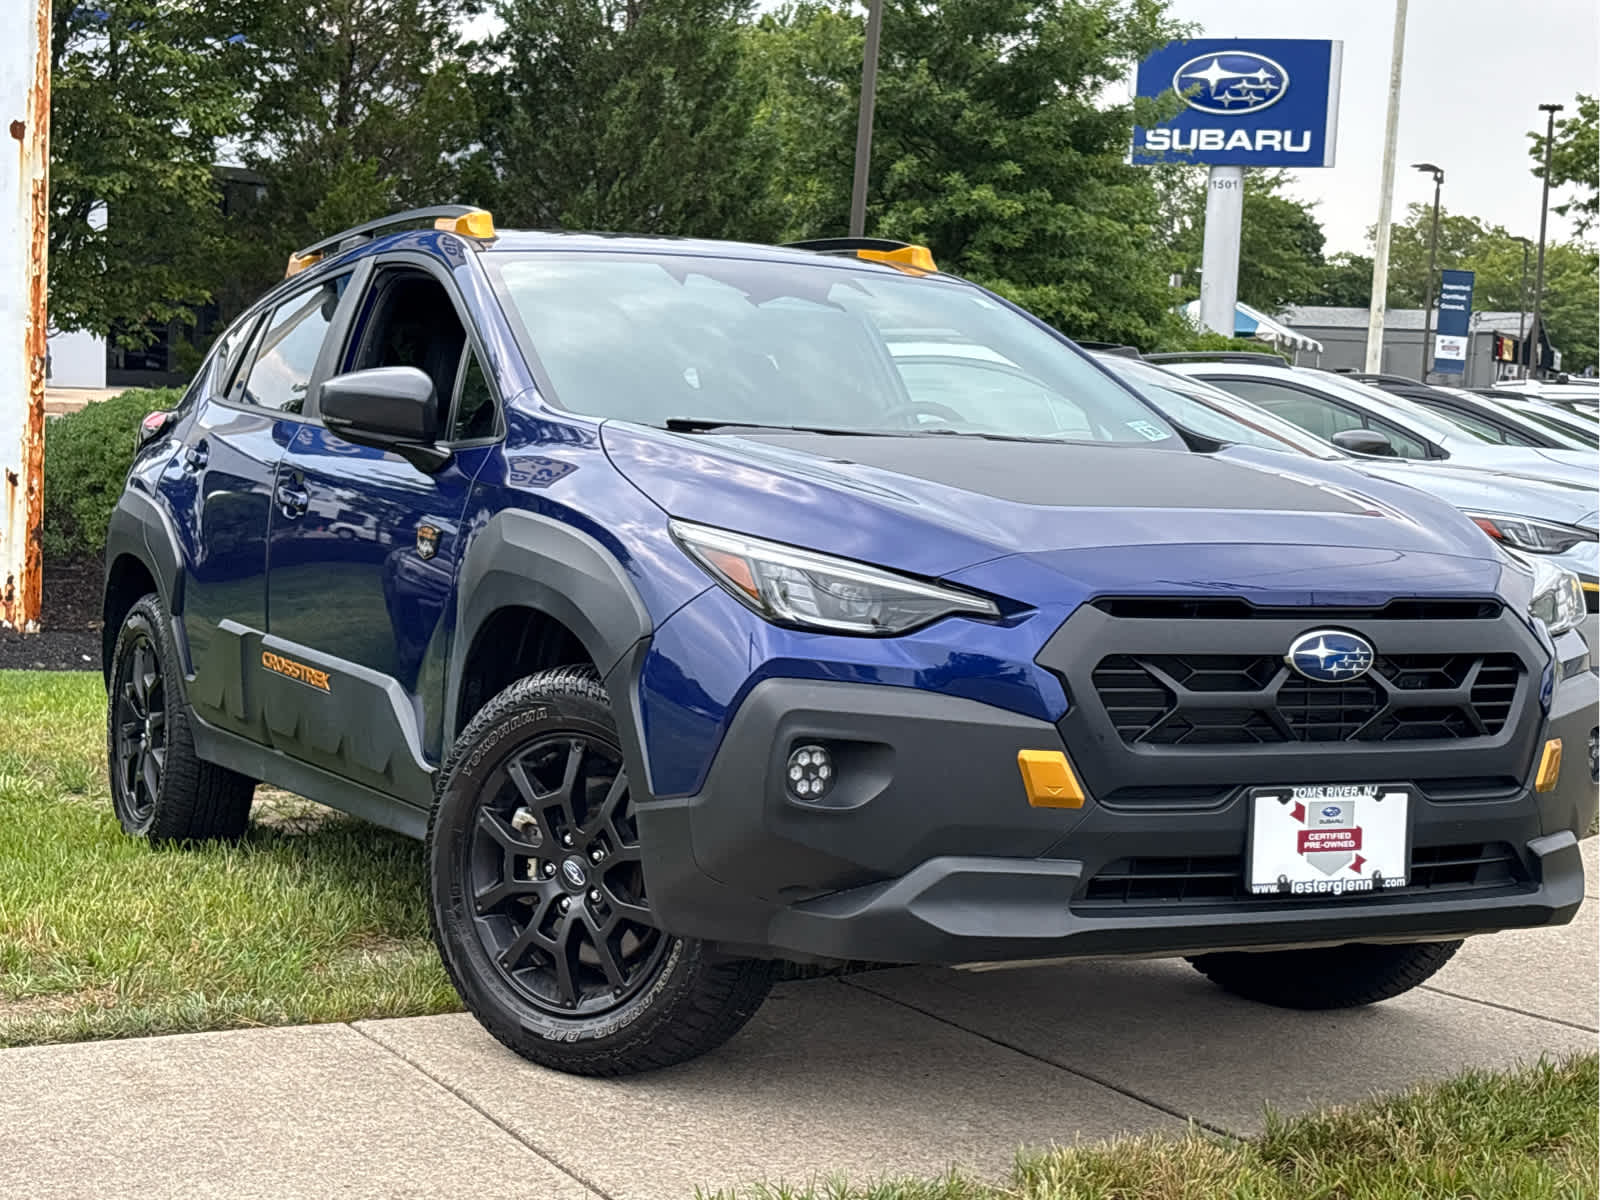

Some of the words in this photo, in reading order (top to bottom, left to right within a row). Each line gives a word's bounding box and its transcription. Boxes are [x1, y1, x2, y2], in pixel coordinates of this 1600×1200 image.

[1145, 128, 1312, 152] SUBARU
[1212, 180, 1238, 190] 1501
[262, 651, 331, 691] CROSSTREK
[461, 706, 548, 777] YOKOHAMA
[1293, 787, 1324, 799] TOMS
[1364, 785, 1379, 796] NJ
[1308, 831, 1352, 841] CERTIFIED
[1303, 840, 1356, 850] PRE-OWNED
[1291, 877, 1374, 896] lesterglenn
